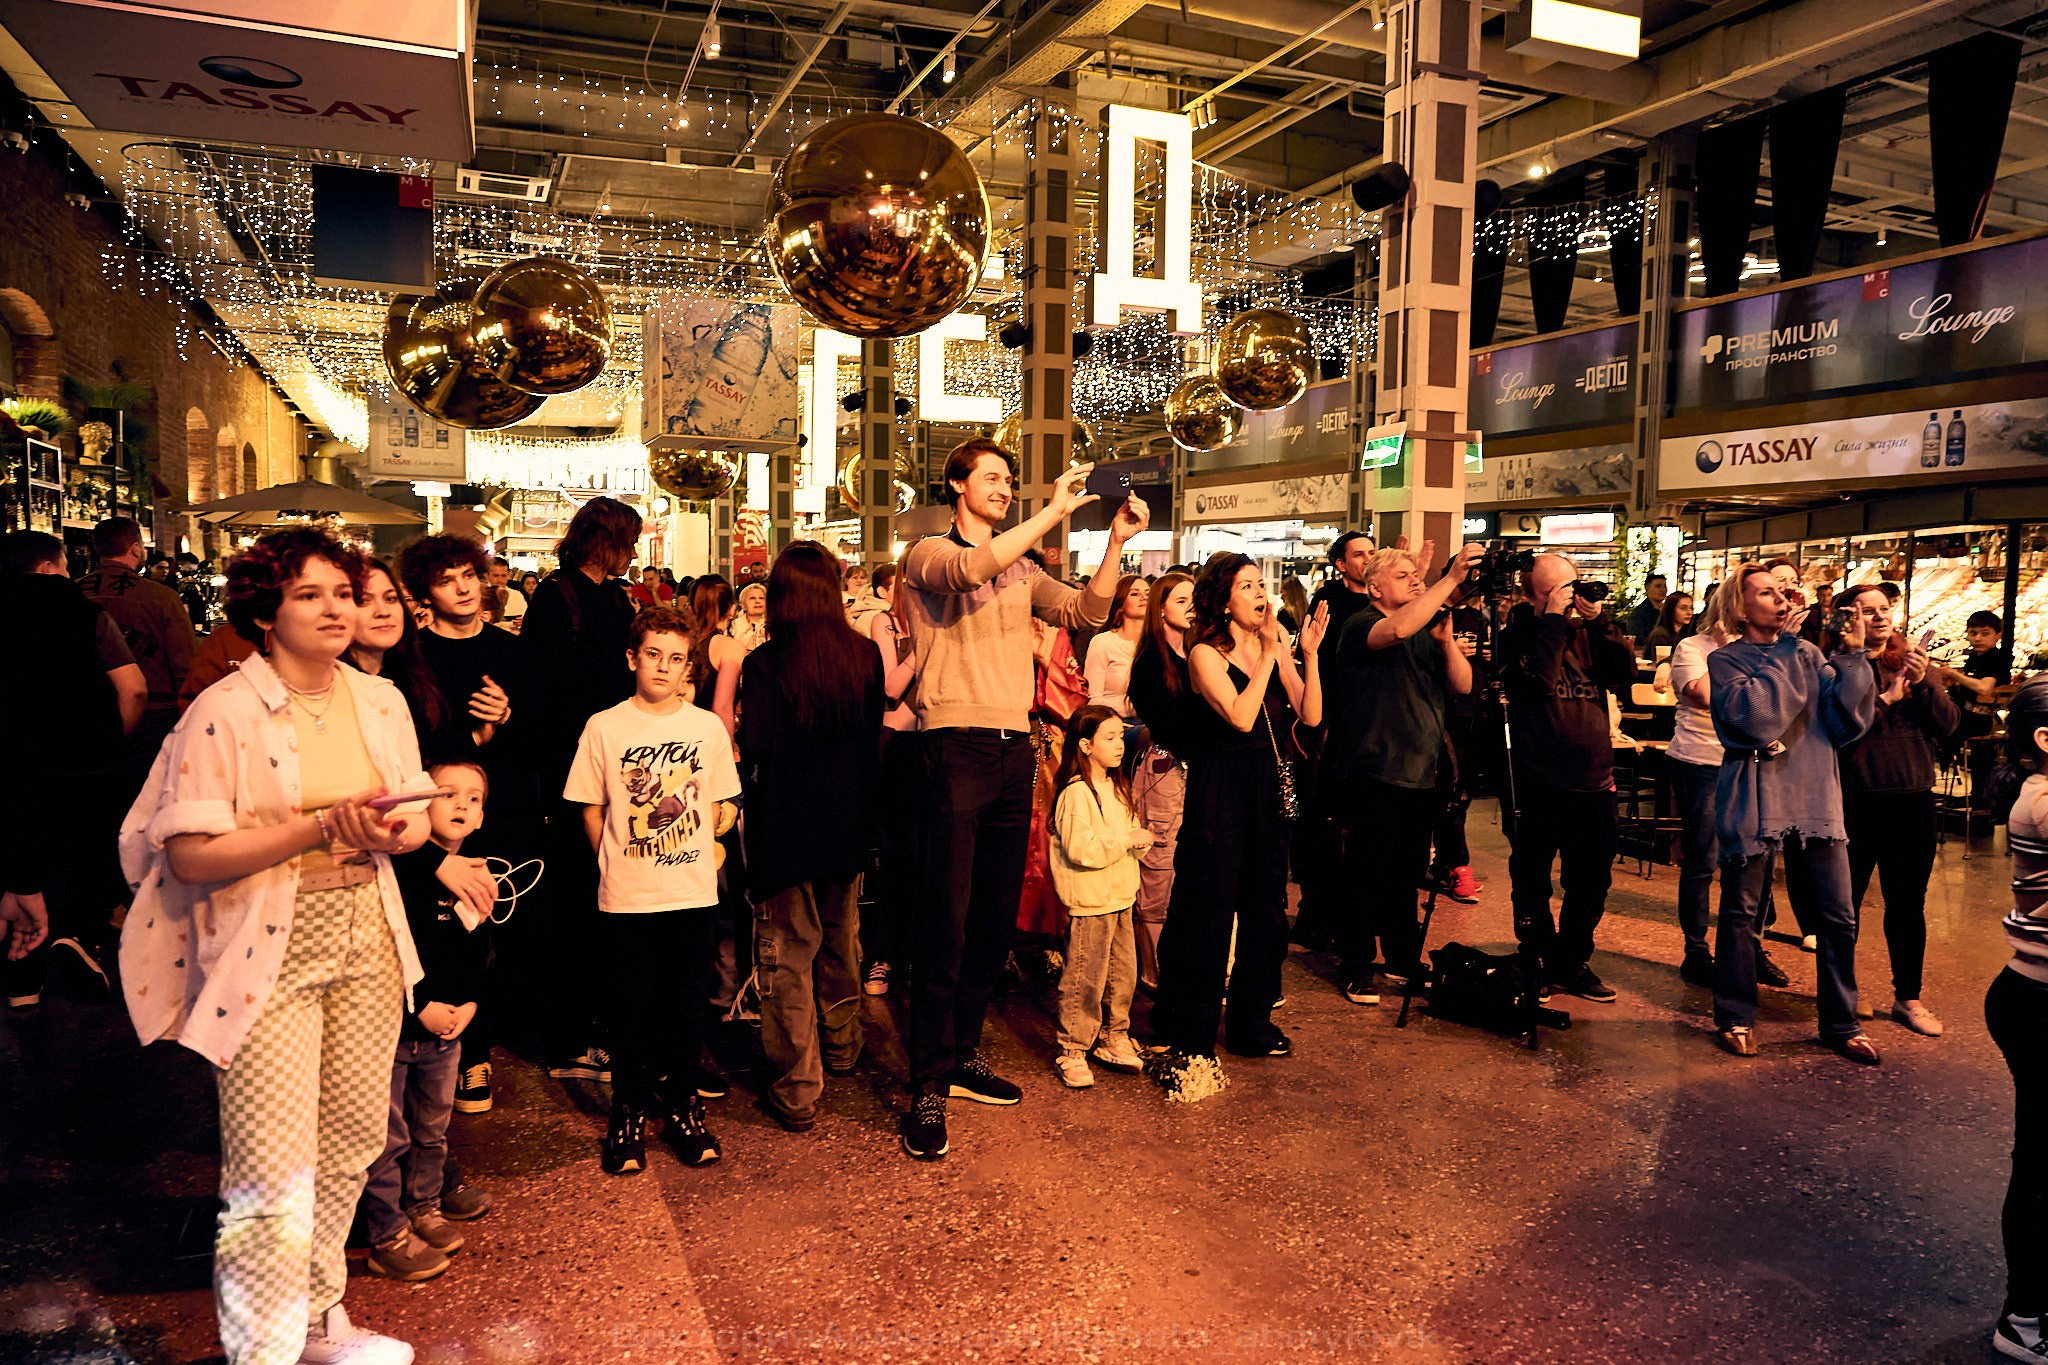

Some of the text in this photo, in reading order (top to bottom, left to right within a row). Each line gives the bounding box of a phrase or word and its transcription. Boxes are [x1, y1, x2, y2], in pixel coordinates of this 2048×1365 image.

[93, 73, 419, 125] TASSAY
[1897, 293, 2016, 344] Lounge
[1725, 318, 1839, 356] PREMIUM
[1724, 343, 1838, 371] ПРОСТРАНСТВО
[704, 376, 748, 405] TASSAY
[1494, 371, 1556, 410] Lounge
[1267, 414, 1305, 445] Lounge
[382, 458, 412, 466] TASSAY
[1727, 436, 1909, 466] TASSAY Сила жизни
[1207, 494, 1240, 510] TASSAY
[620, 740, 702, 769] КРУТОЙ
